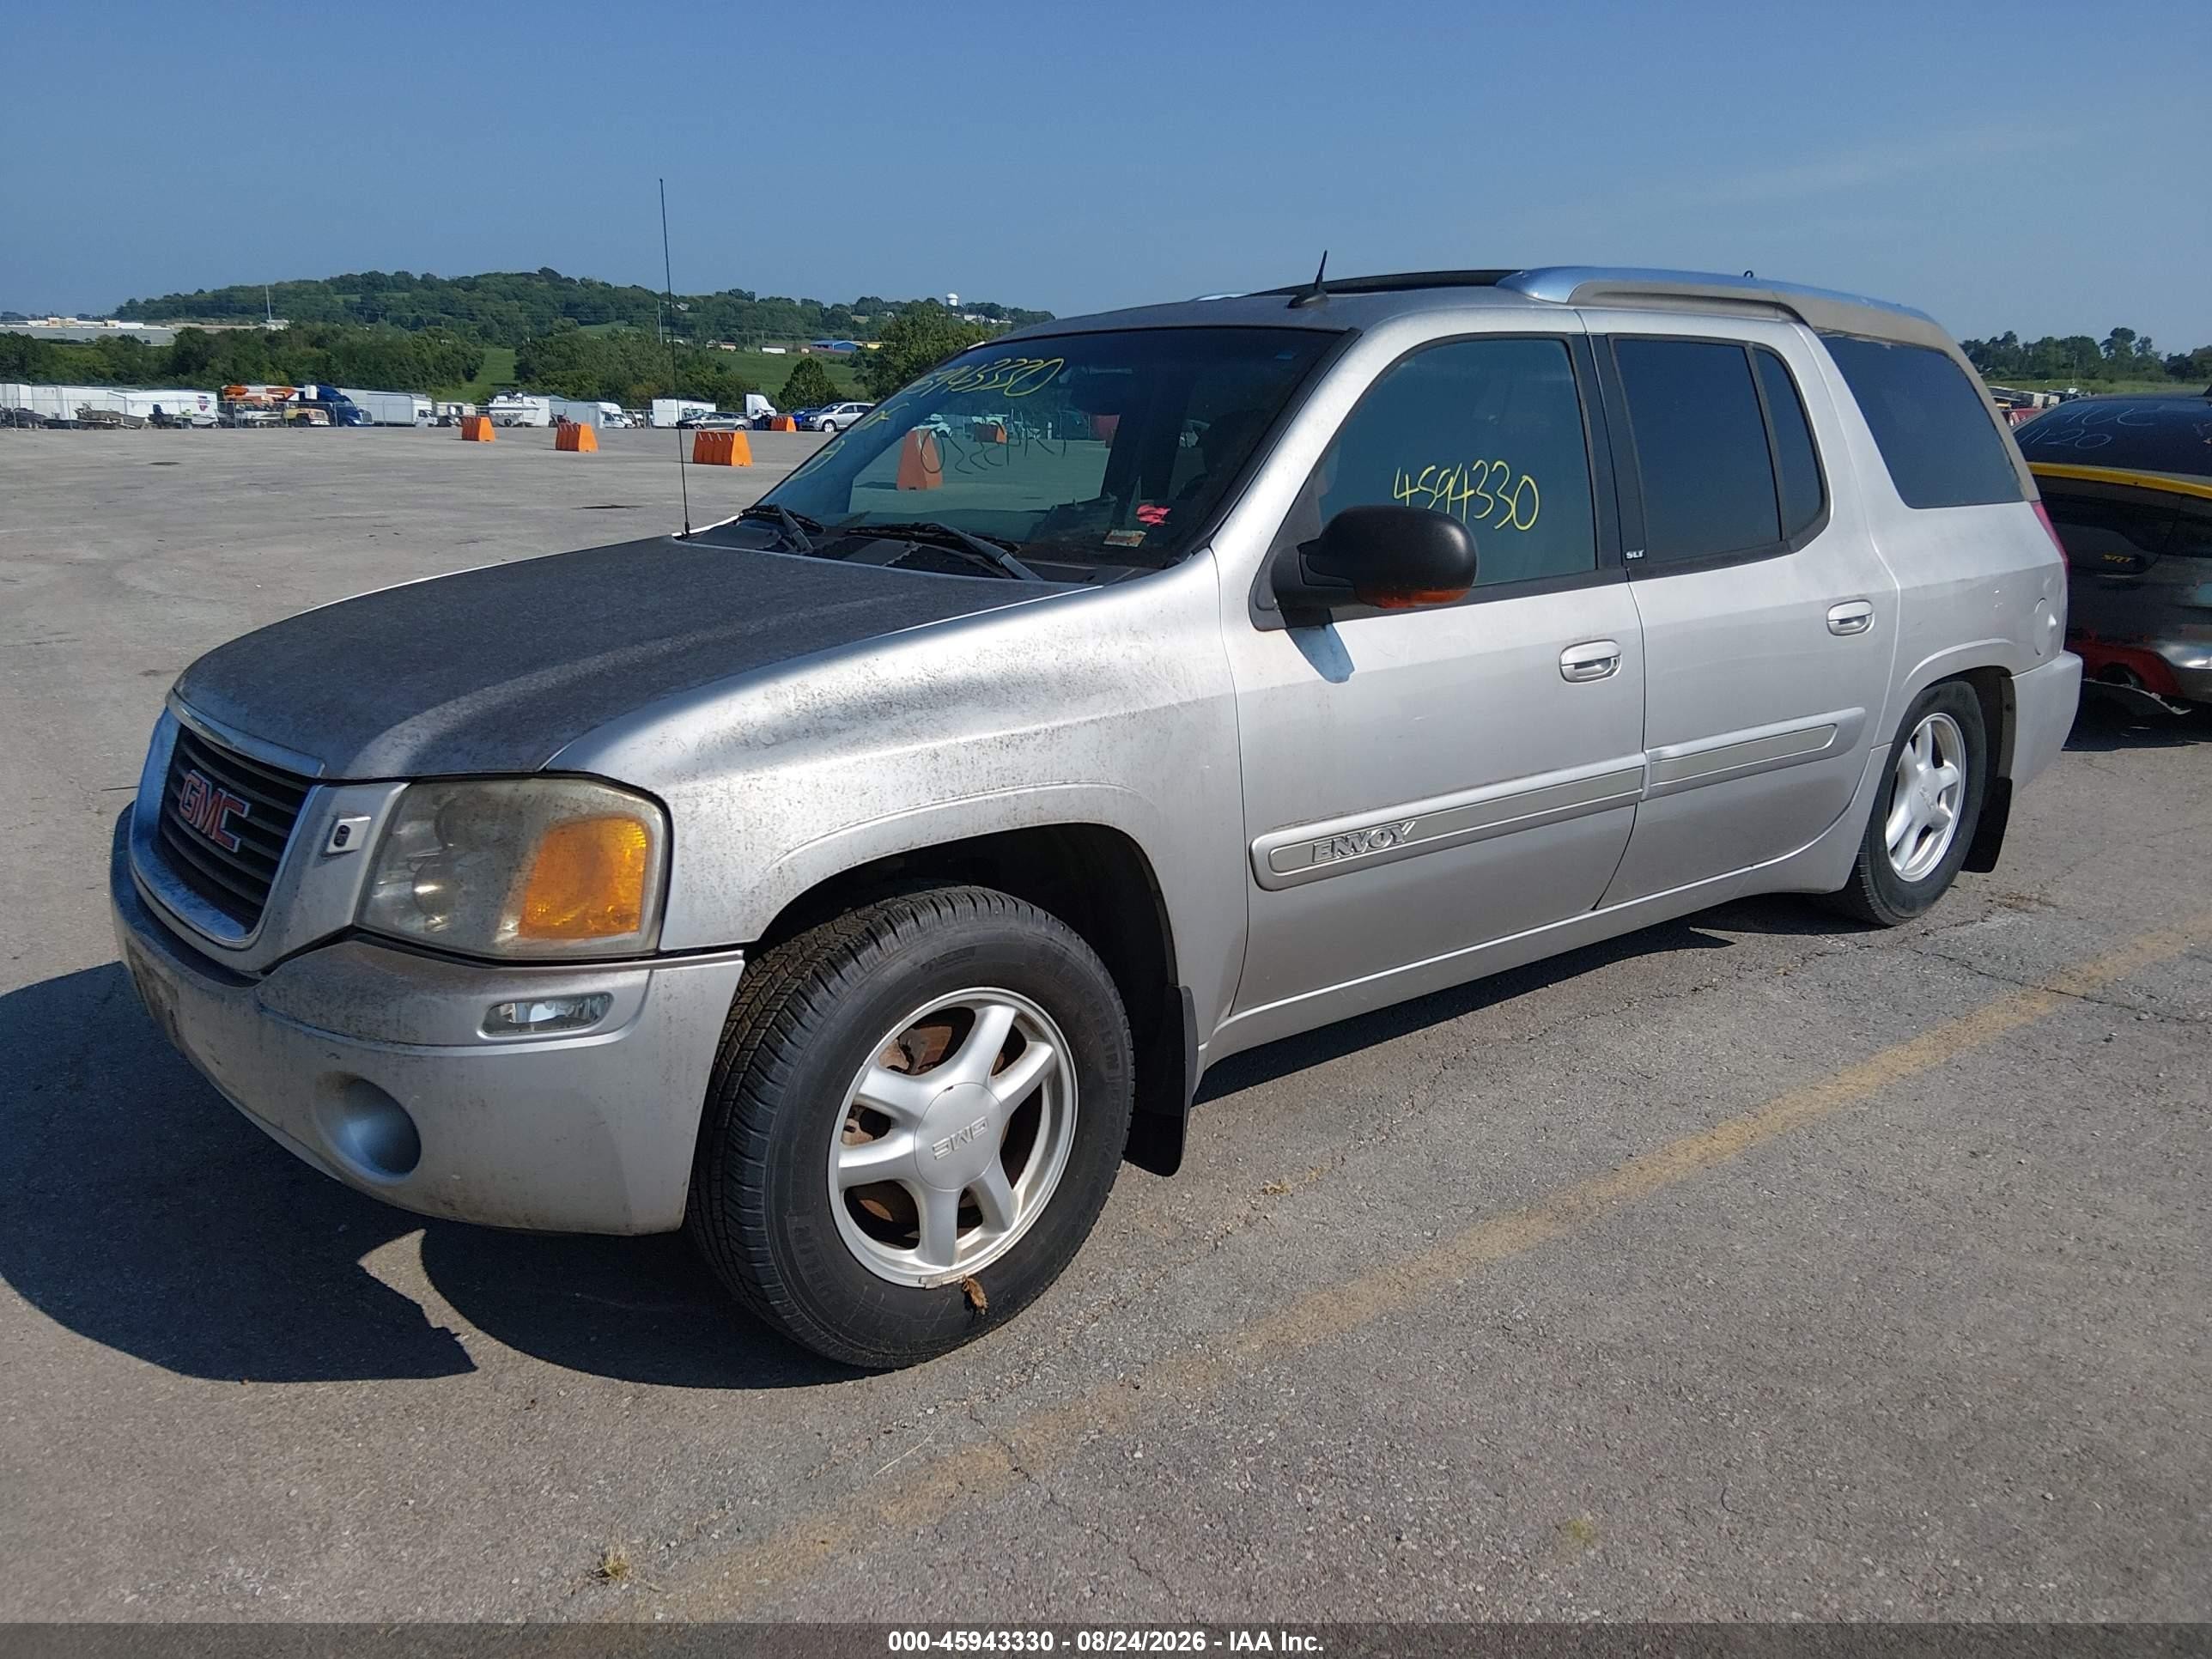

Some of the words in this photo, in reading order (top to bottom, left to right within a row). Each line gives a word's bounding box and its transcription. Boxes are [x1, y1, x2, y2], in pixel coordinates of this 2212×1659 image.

[179, 769, 252, 854] GMC
[1312, 820, 1417, 864] ENVOY
[932, 1116, 988, 1161] GMC
